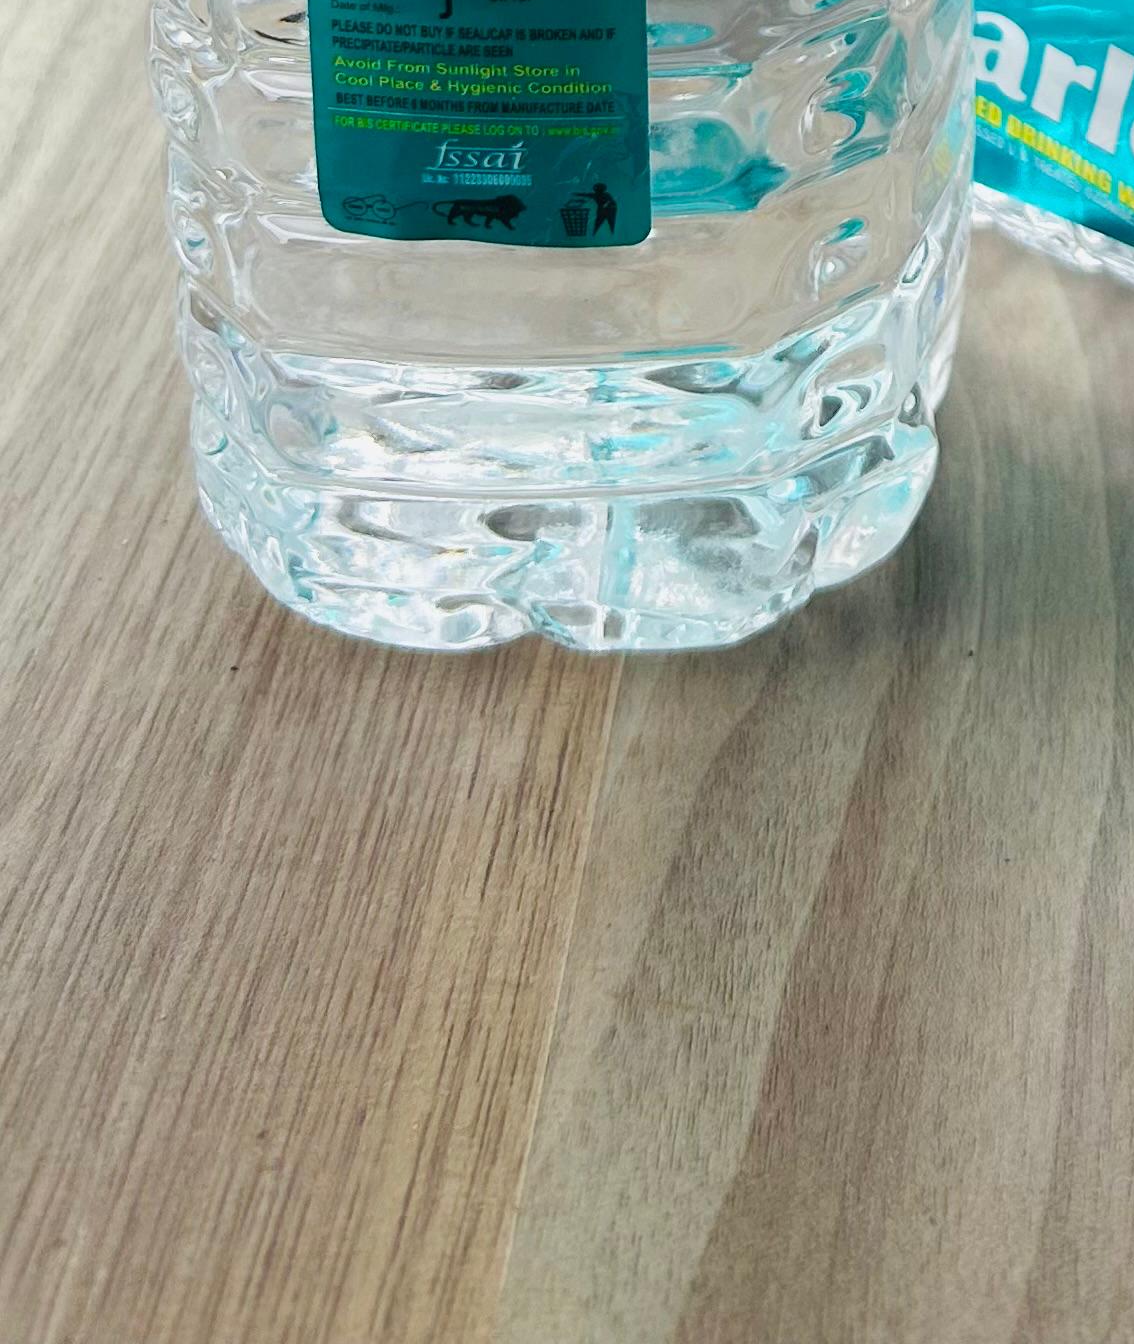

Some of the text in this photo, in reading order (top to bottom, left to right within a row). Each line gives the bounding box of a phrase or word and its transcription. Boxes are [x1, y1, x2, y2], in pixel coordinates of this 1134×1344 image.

[331, 19, 374, 34] PLEASE
[375, 22, 393, 35] DO
[395, 23, 418, 37] NOT
[529, 26, 577, 41] BROKEN
[579, 26, 604, 40] AND
[334, 55, 581, 79] Avoid From Sunlight Store in
[334, 72, 613, 96] Cool Place & Hygienic Condition
[336, 91, 363, 105] BEST
[366, 94, 409, 109] BEFORE
[467, 99, 499, 113] FROM
[501, 100, 584, 114] MANUFACTURE
[586, 100, 616, 113] DATE
[334, 115, 354, 128] FOR
[375, 118, 439, 134] CERTIFICATE
[440, 121, 481, 135] PLEASE
[483, 125, 505, 136] LOG
[1006, 113, 1112, 196] DRINKING
